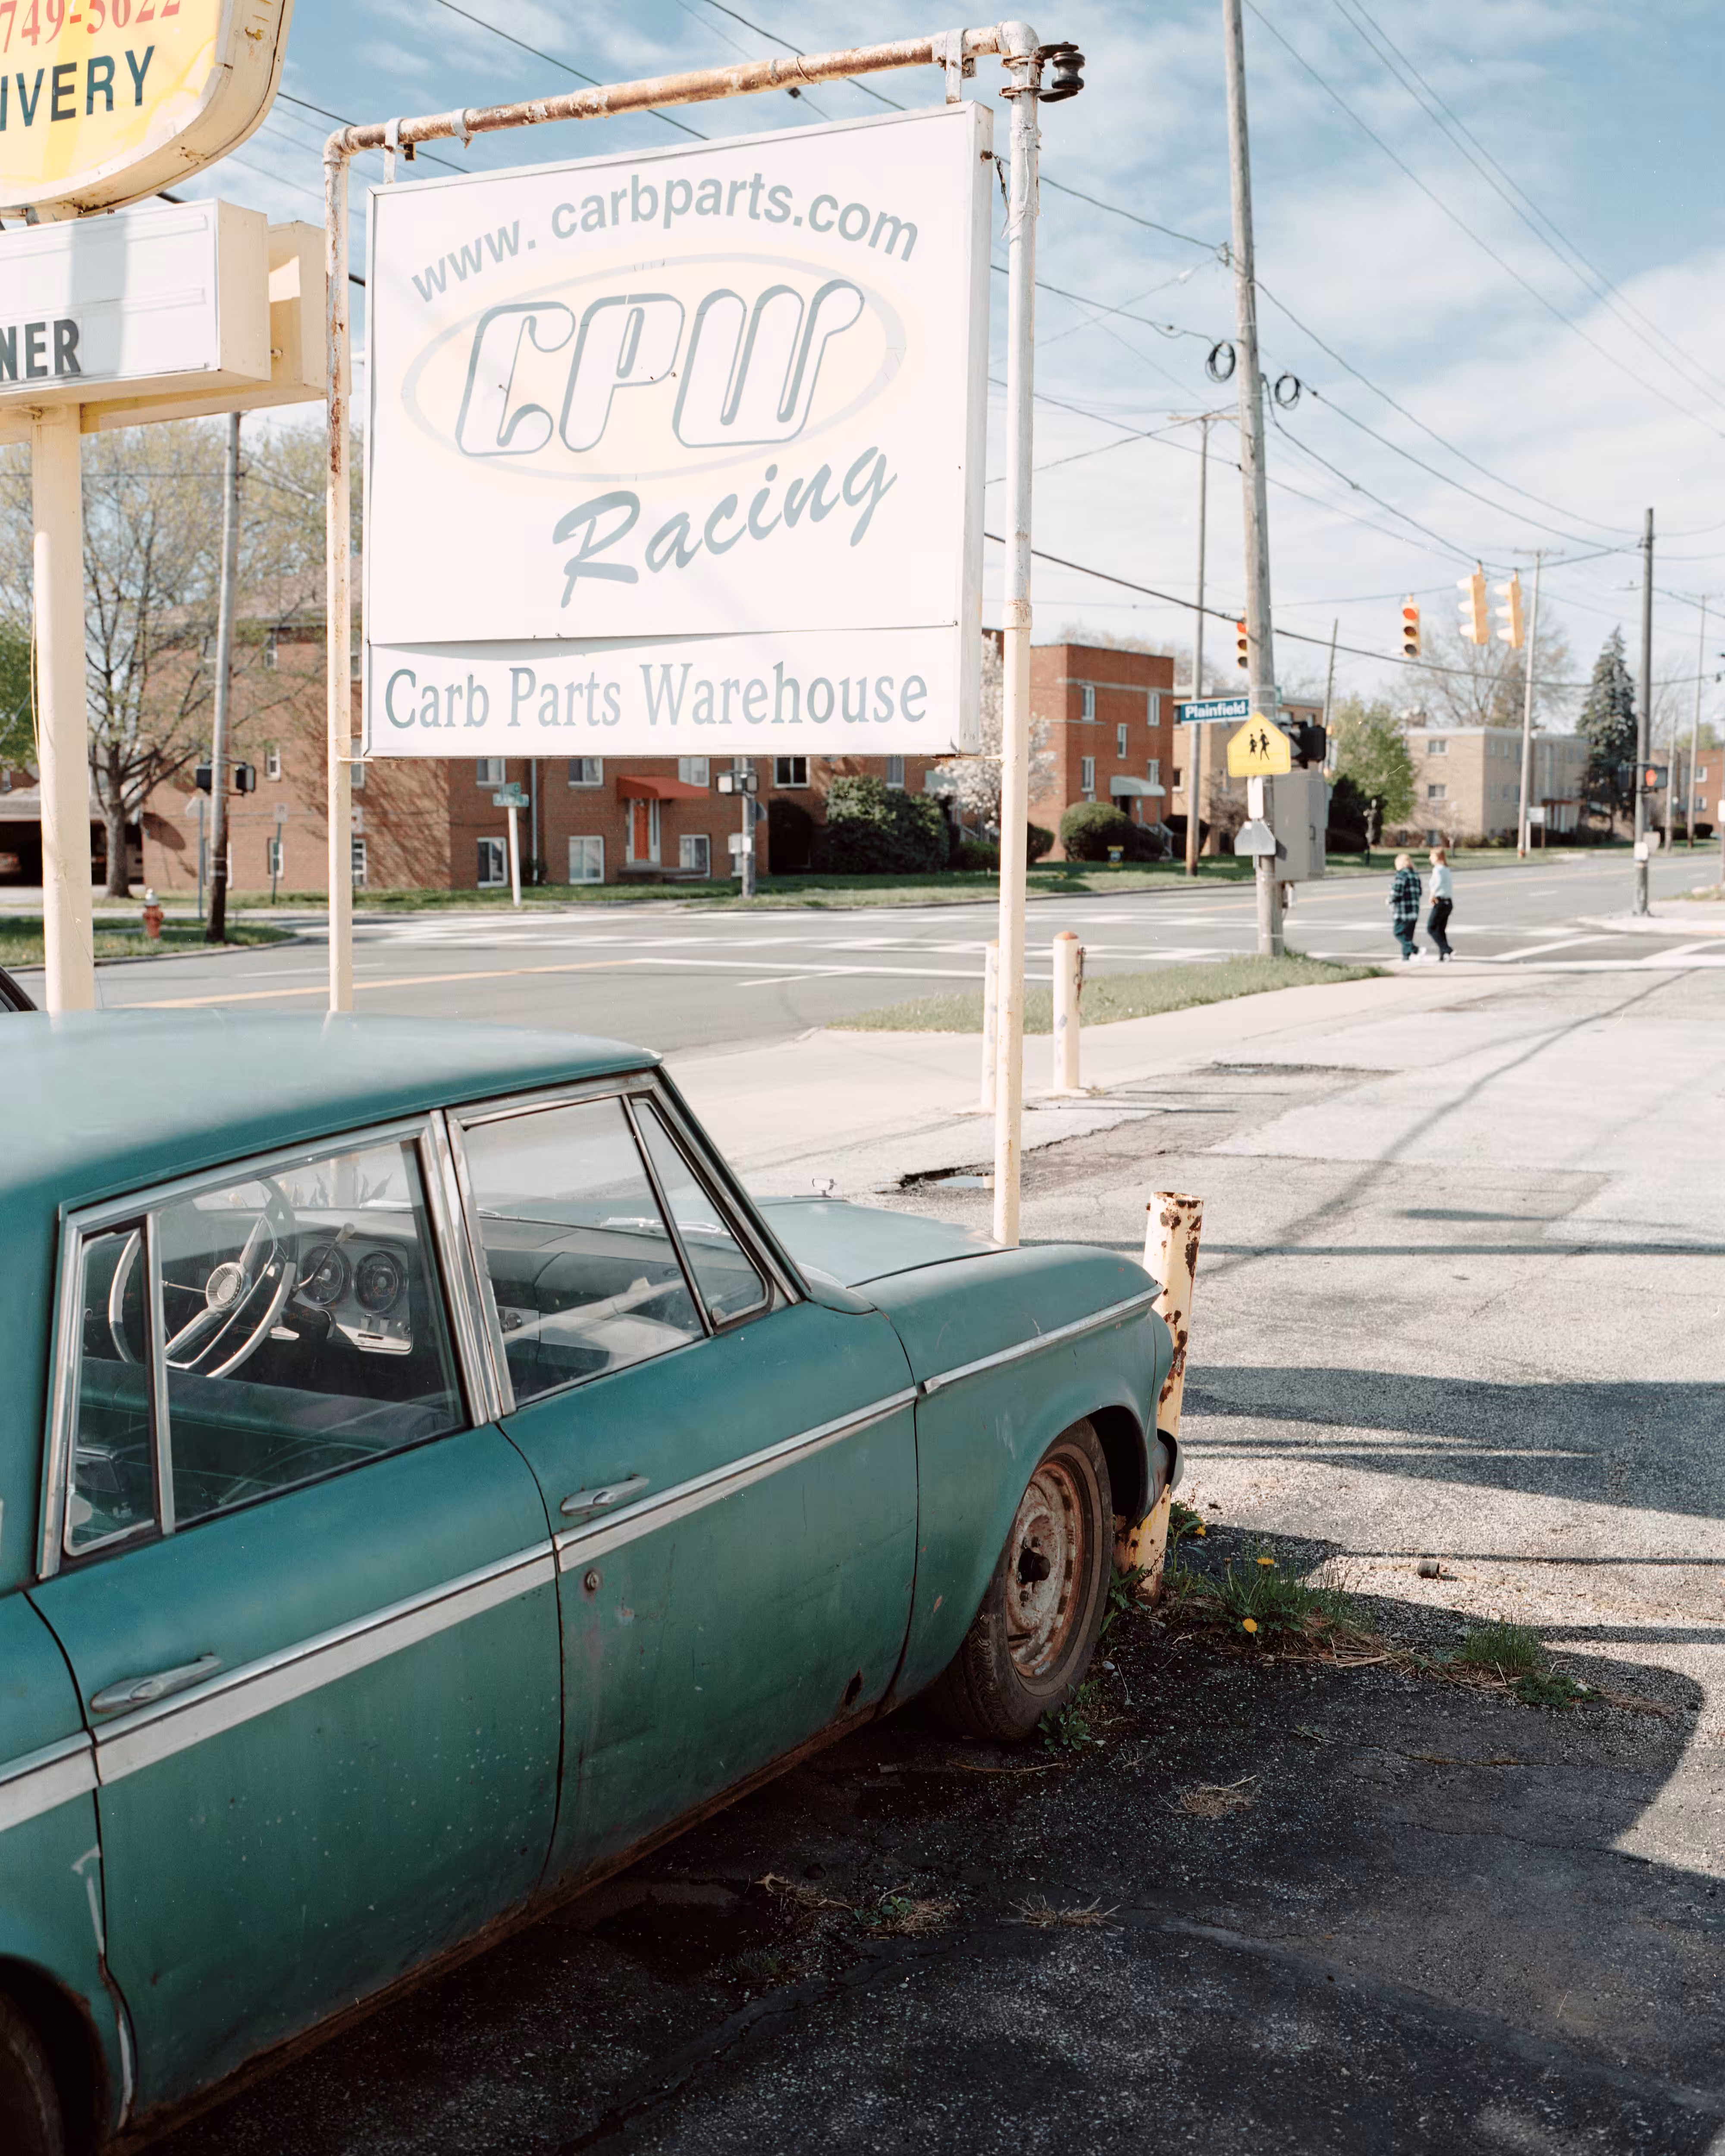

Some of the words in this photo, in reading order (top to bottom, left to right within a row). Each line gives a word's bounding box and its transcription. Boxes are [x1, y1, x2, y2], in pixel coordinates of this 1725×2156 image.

[0, 45, 155, 131] IVERY
[551, 173, 918, 262] carbparts.com
[0, 319, 81, 382] NER
[455, 279, 865, 457] CPW
[552, 446, 898, 608] Racing
[385, 668, 489, 729] Carb
[507, 667, 621, 727] Parts
[639, 661, 927, 726] Warehouse
[1185, 701, 1245, 718] Plainfield
